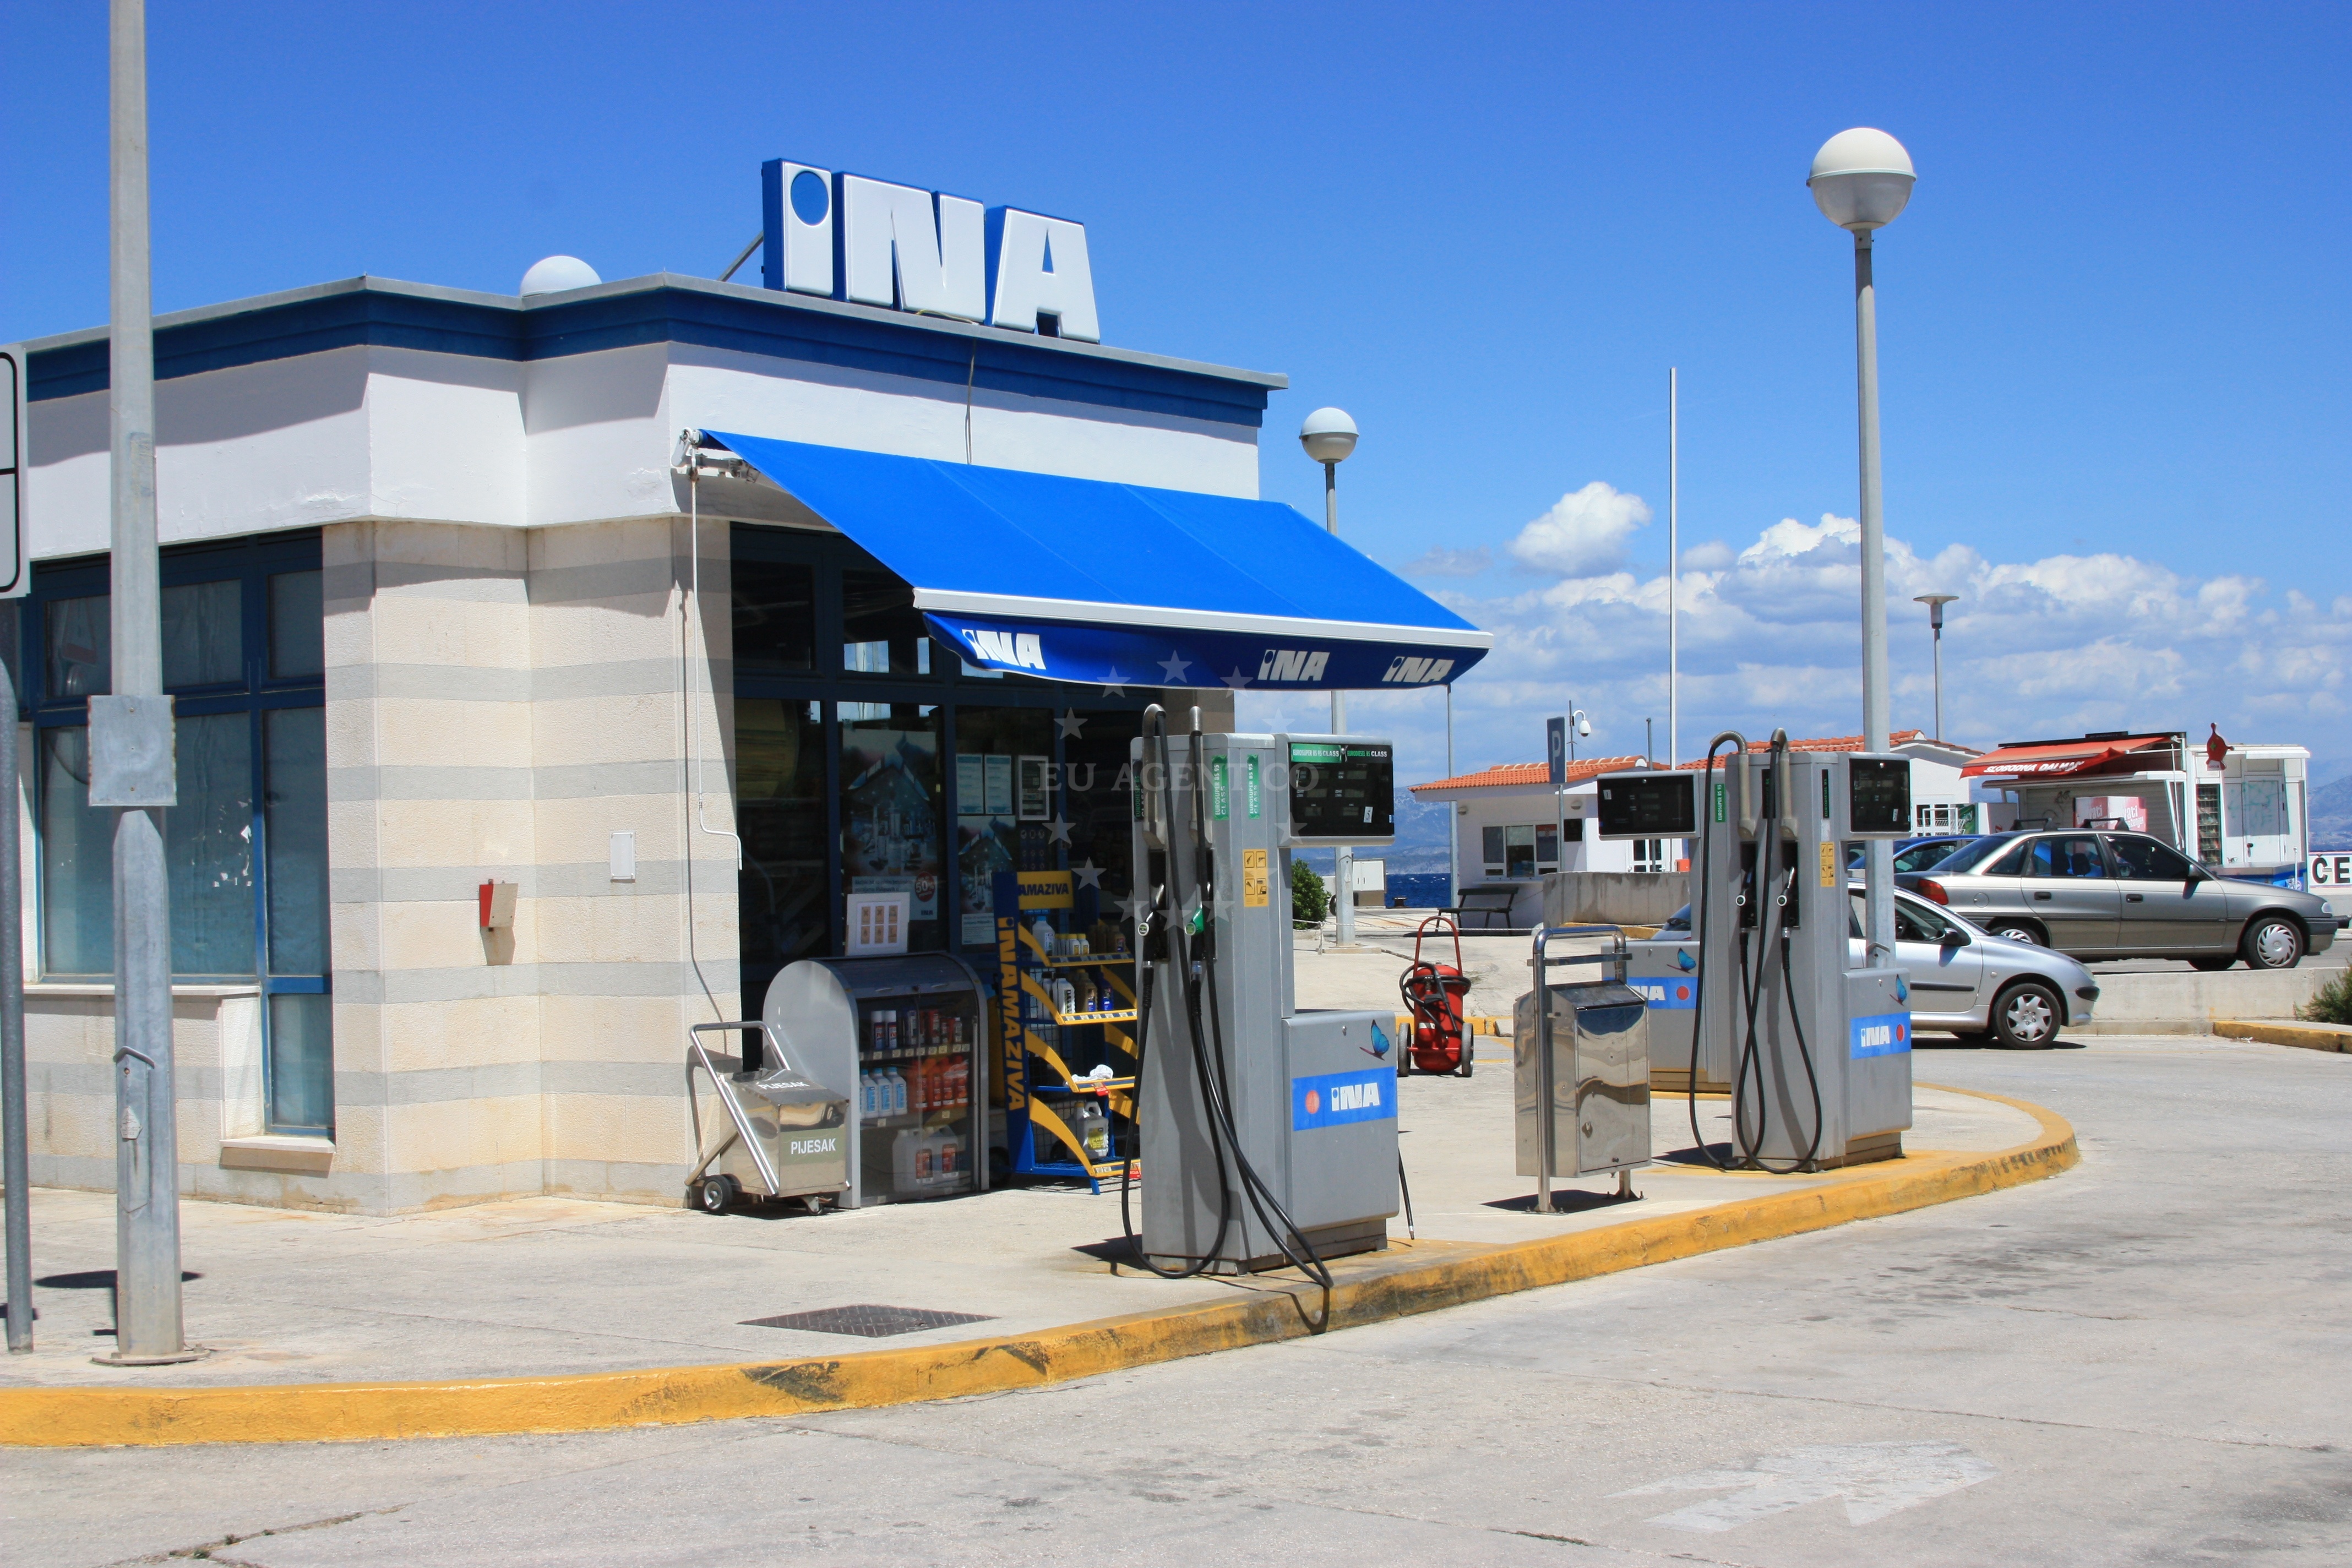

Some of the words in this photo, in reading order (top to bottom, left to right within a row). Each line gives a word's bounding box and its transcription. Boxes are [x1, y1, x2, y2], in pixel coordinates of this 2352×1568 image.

[1551, 730, 1561, 773] P
[1984, 764, 2038, 772] SLOBODNA
[2038, 761, 2084, 772] DALMA
[1630, 985, 1666, 1001] NA
[758, 1080, 811, 1091] PIJESAK
[790, 1137, 837, 1155] PIJESAK
